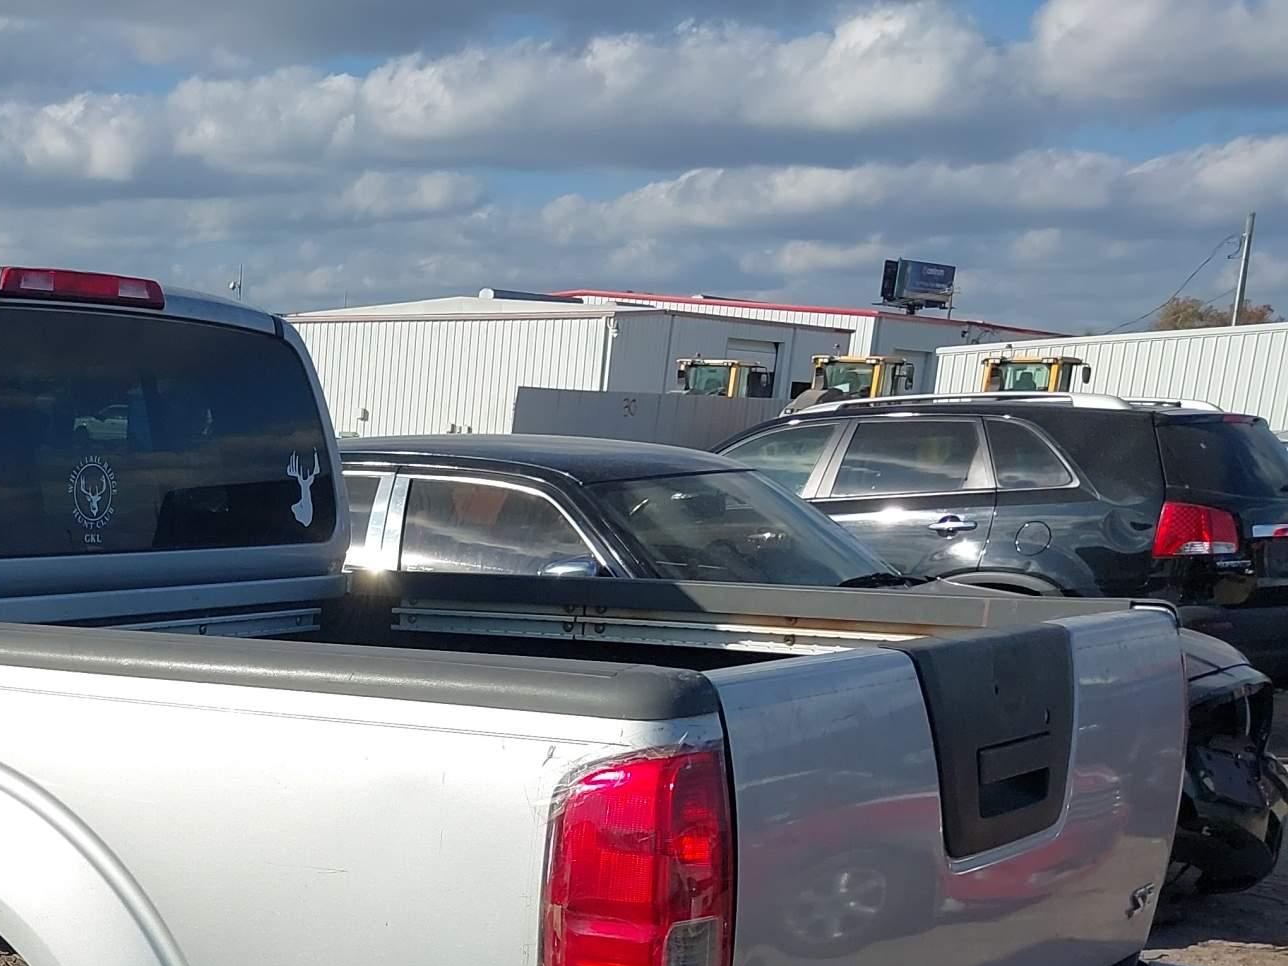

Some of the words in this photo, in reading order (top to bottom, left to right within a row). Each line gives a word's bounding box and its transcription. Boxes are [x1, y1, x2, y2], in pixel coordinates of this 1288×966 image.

[72, 508, 94, 530] HUNT
[96, 508, 115, 529] CLUB
[84, 533, 103, 544] GKL
